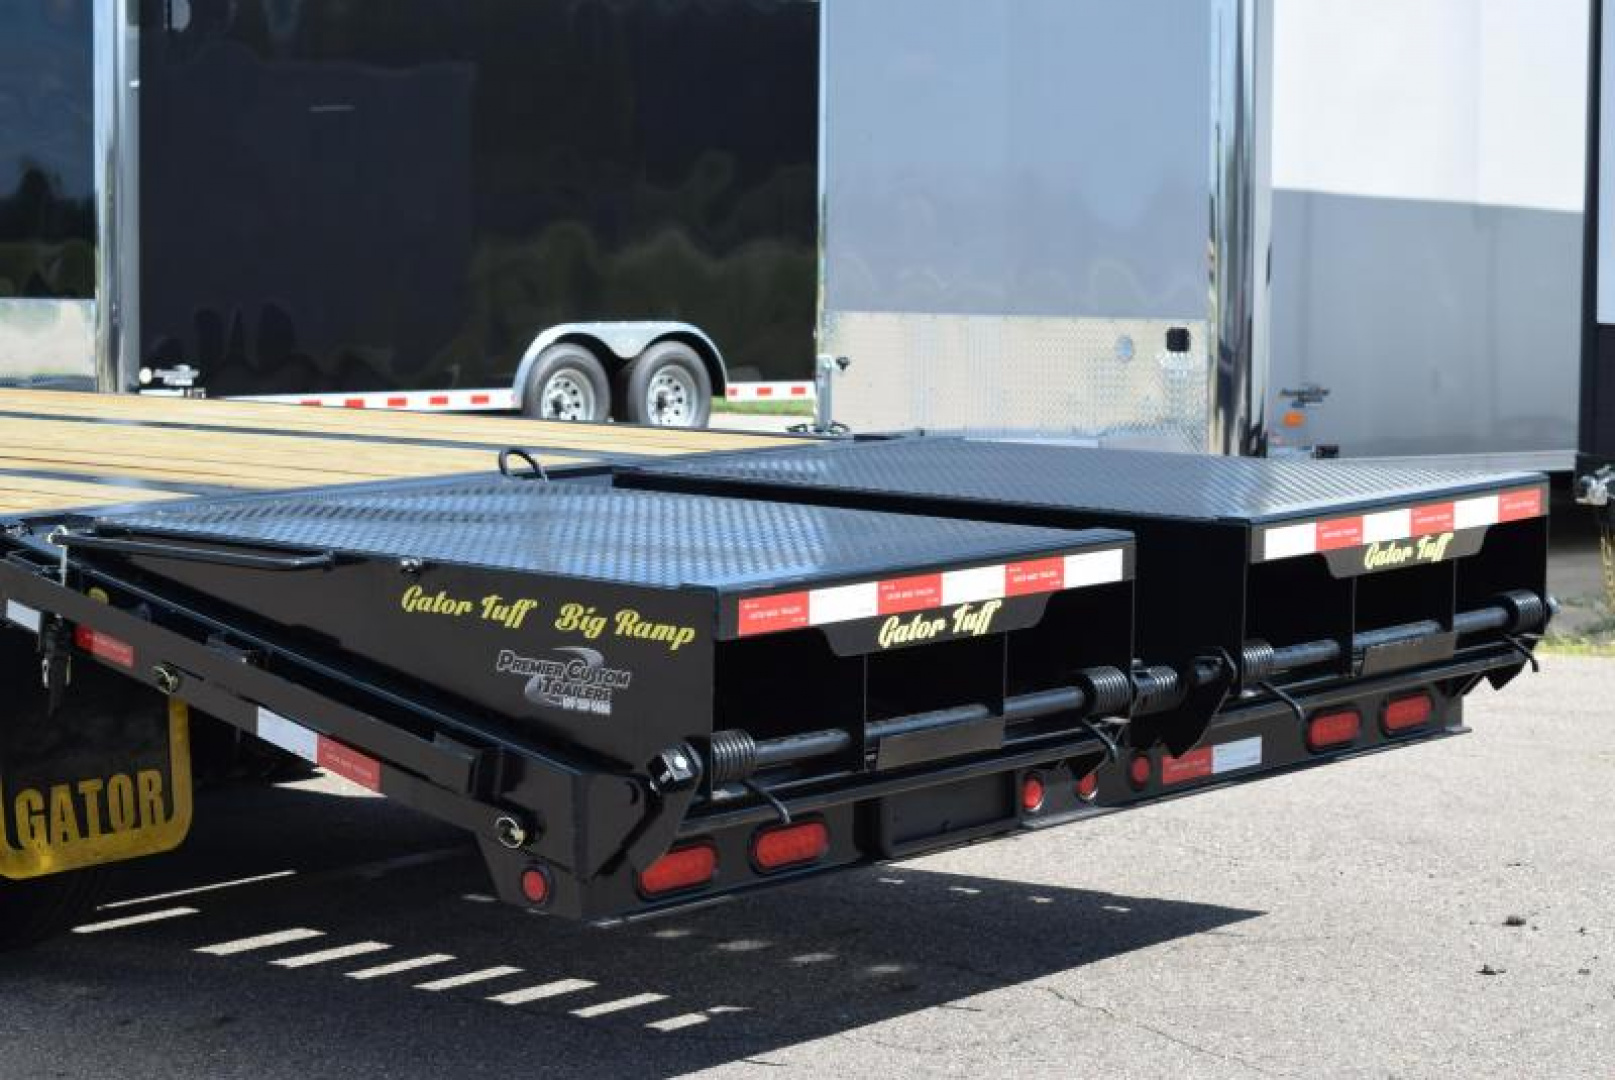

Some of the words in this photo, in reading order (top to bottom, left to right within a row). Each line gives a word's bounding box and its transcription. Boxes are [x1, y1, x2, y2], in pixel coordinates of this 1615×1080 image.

[1364, 541, 1413, 570] Gator
[1416, 532, 1454, 563] Tuff
[401, 585, 473, 616] Gator
[481, 593, 538, 629] Tuff
[555, 603, 607, 639] Big
[615, 609, 696, 650] Ramp
[878, 614, 945, 649] Gator
[952, 599, 1002, 635] Tuff
[496, 649, 565, 677] PREMIER
[567, 659, 631, 690] CUSTOM
[542, 677, 612, 700] TRAILERS
[15, 769, 165, 850] GATOR
